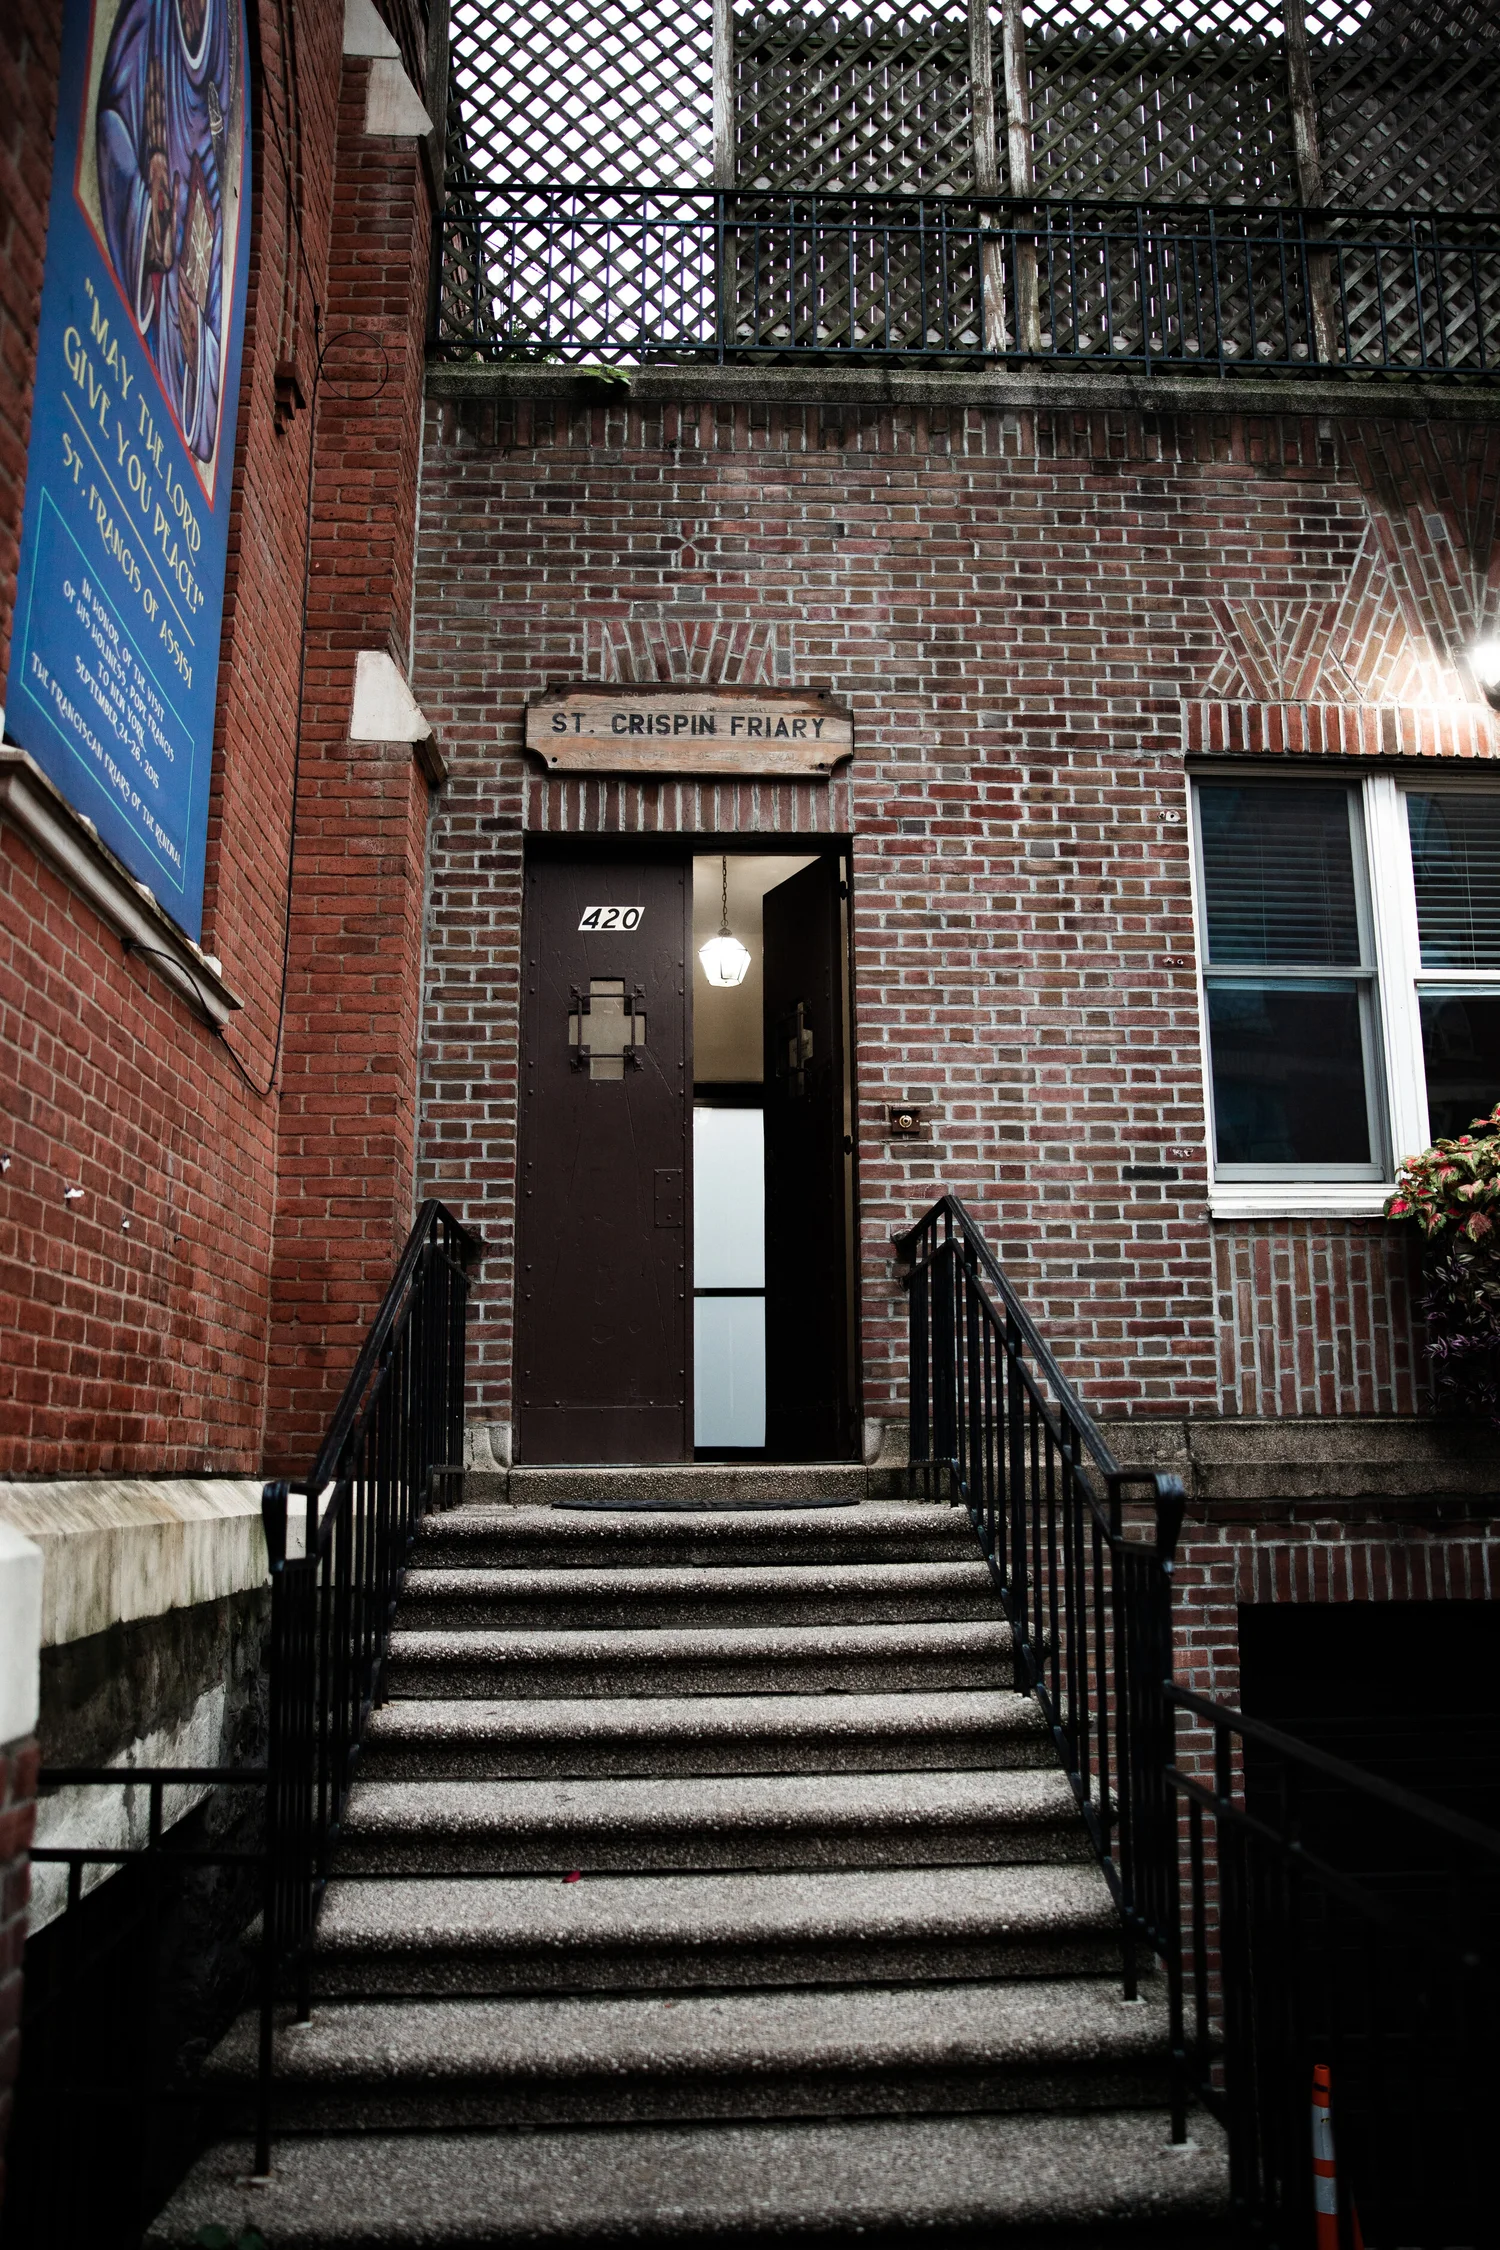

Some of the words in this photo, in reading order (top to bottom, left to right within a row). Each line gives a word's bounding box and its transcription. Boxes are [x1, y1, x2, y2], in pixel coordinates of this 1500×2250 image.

[64, 326, 110, 438] GIVE
[118, 421, 152, 513] YOU
[138, 393, 164, 479] THE
[166, 463, 200, 567] LORD
[82, 577, 92, 603] IN
[92, 596, 120, 660] HONOR
[122, 647, 132, 668] OF
[133, 664, 146, 694] THE
[147, 686, 165, 723] VISIT
[89, 483, 141, 593] FRANCIS
[143, 588, 159, 622] OF
[160, 619, 192, 690] ASSISI
[63, 580, 76, 604] OF
[76, 599, 90, 629] HIS
[130, 685, 147, 722] POPE
[148, 714, 175, 763] FRANCIS
[75, 655, 120, 740] SEPTEMBER
[144, 759, 160, 789] 2015
[98, 660, 110, 687] TO
[110, 680, 126, 714] NEW
[127, 705, 146, 753] YORK
[551, 712, 595, 734] ST.
[611, 713, 716, 736] CRISPIN
[730, 716, 826, 739] FRIARY
[31, 651, 49, 689] THE
[51, 680, 104, 761] FRANCISCAN
[104, 753, 130, 803] FRIARS
[131, 792, 142, 812] OF
[142, 804, 154, 833] THE
[154, 823, 182, 870] RENEWAL
[581, 908, 640, 930] 420
